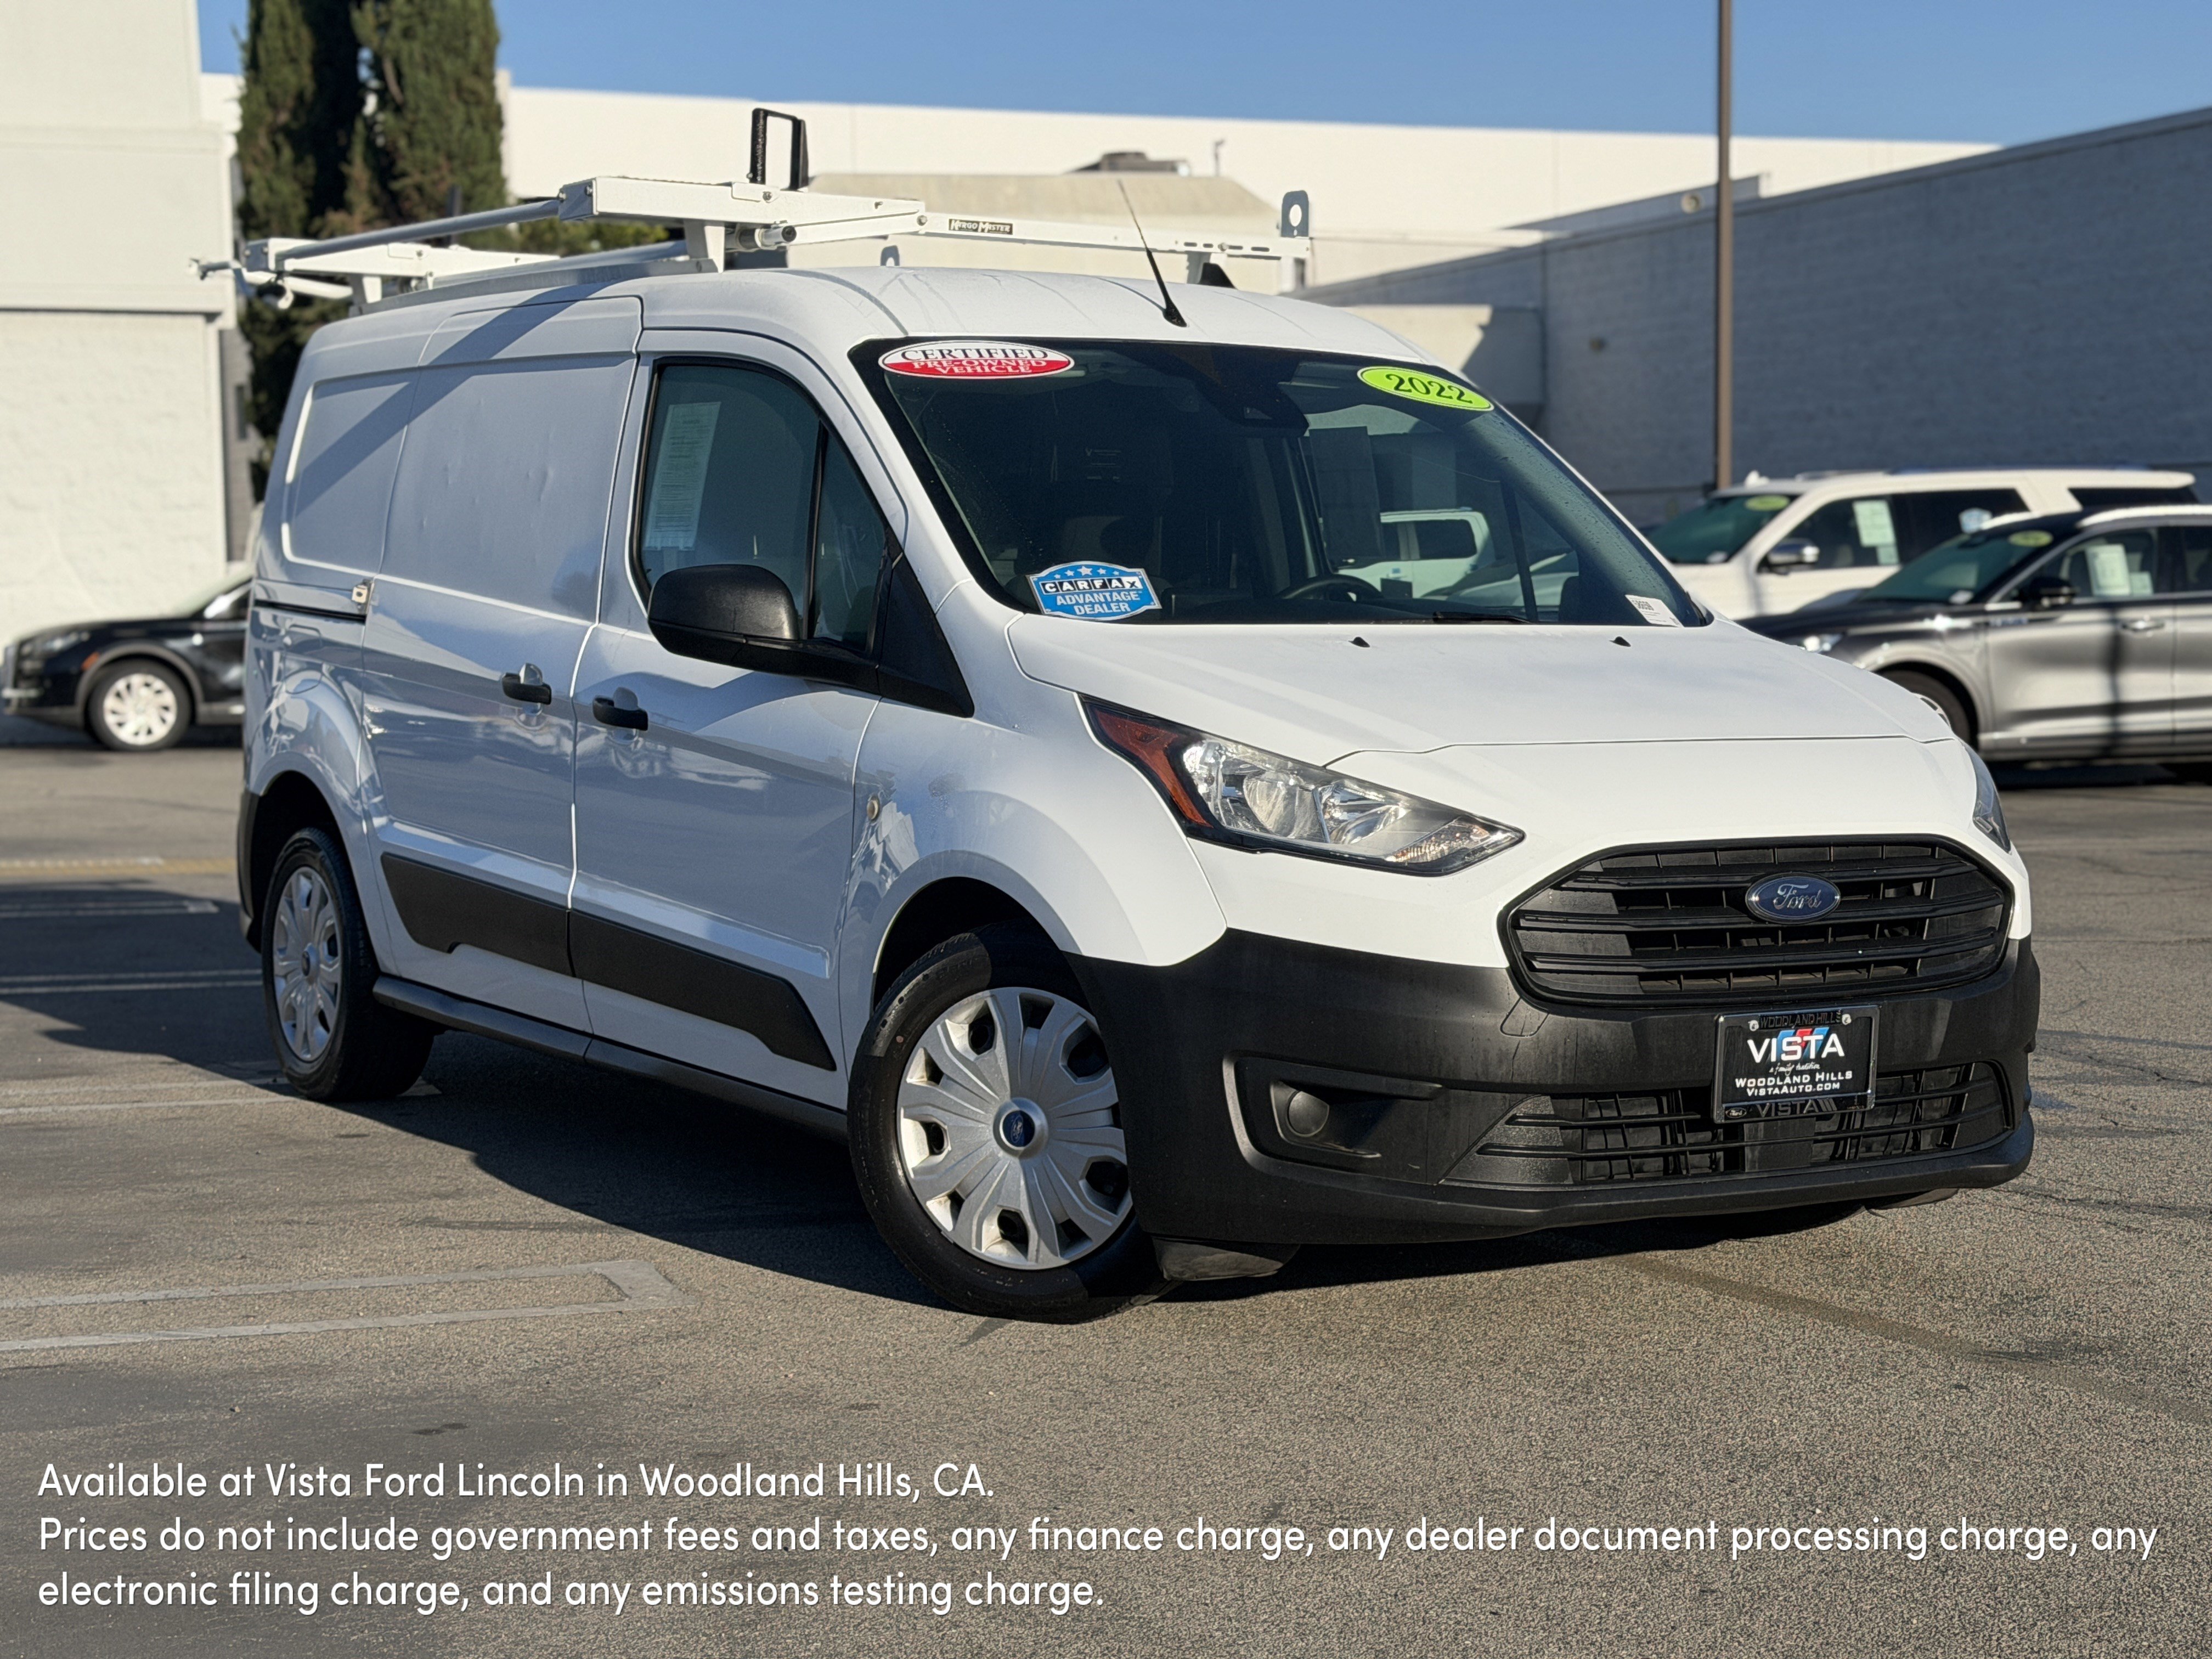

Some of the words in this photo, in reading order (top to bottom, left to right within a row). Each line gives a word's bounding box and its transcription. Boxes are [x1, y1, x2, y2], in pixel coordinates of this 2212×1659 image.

[900, 348, 1048, 361] CERTIFIED
[911, 359, 1047, 369] PRE-OWNED
[934, 365, 1032, 374] VEHICLE
[1385, 373, 1473, 404] 2022
[1042, 578, 1142, 594] CARFAX
[1056, 591, 1141, 606] ADVANTAGE
[1073, 602, 1132, 616] DEALER
[1773, 883, 1822, 910] Ford
[1747, 1033, 1845, 1063] VISTA
[1735, 1074, 1810, 1088] WOODLAND
[1815, 1070, 1853, 1082] HILLS
[1746, 1082, 1840, 1097] VISTAAUTO.COM
[1756, 1099, 1819, 1118] VISTA
